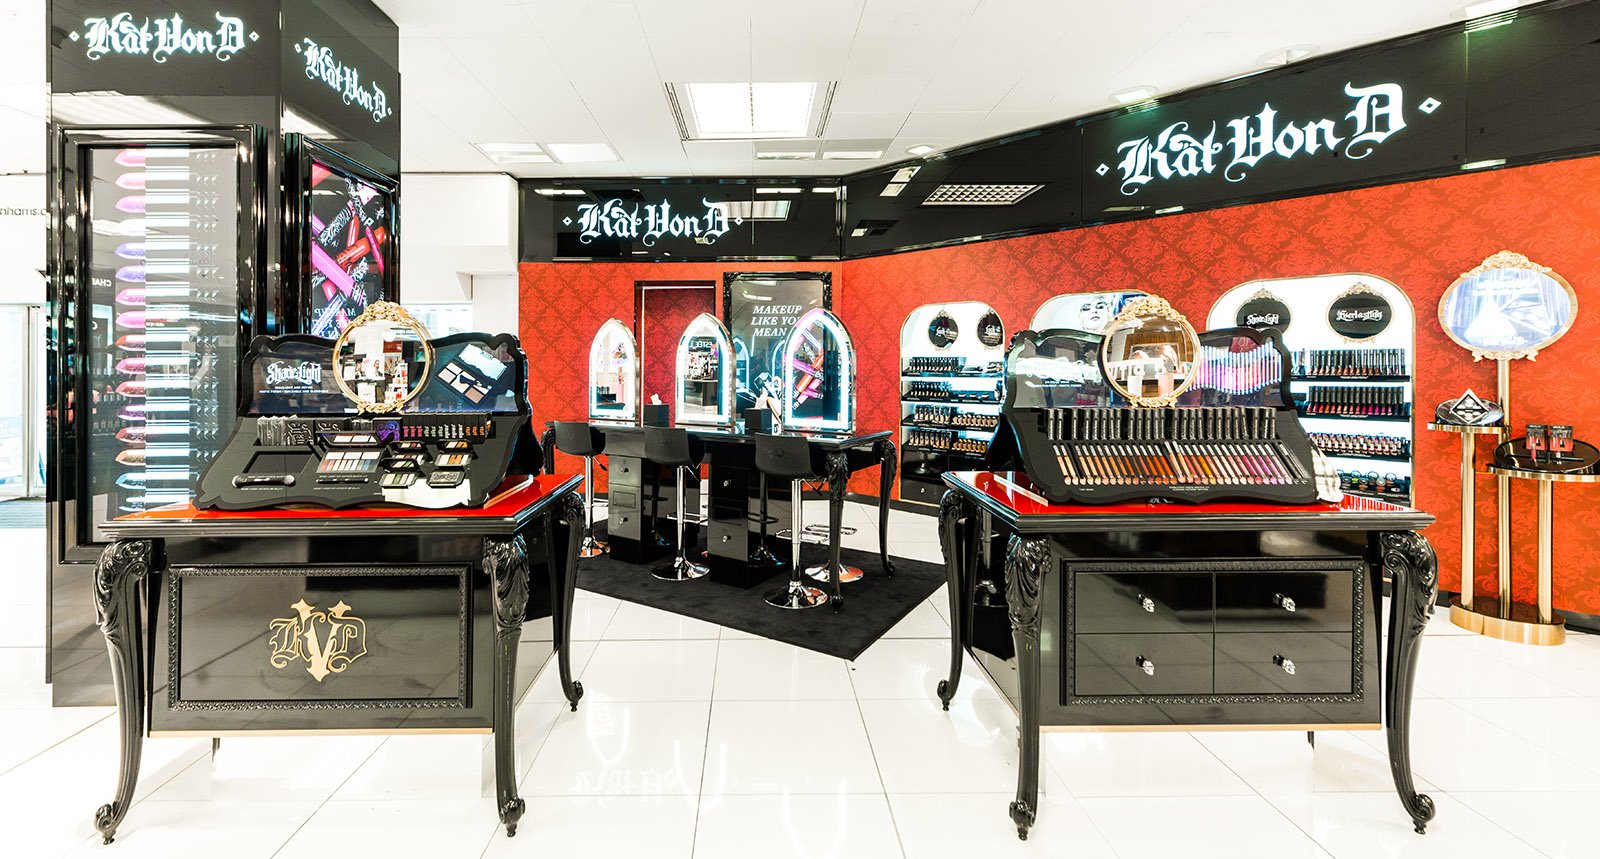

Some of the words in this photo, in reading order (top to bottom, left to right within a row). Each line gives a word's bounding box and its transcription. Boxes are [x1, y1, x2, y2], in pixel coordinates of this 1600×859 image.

[752, 305, 803, 315] MAKEUP
[750, 316, 779, 326] LIKE
[781, 316, 800, 326] YO
[754, 327, 788, 337] MEAN
